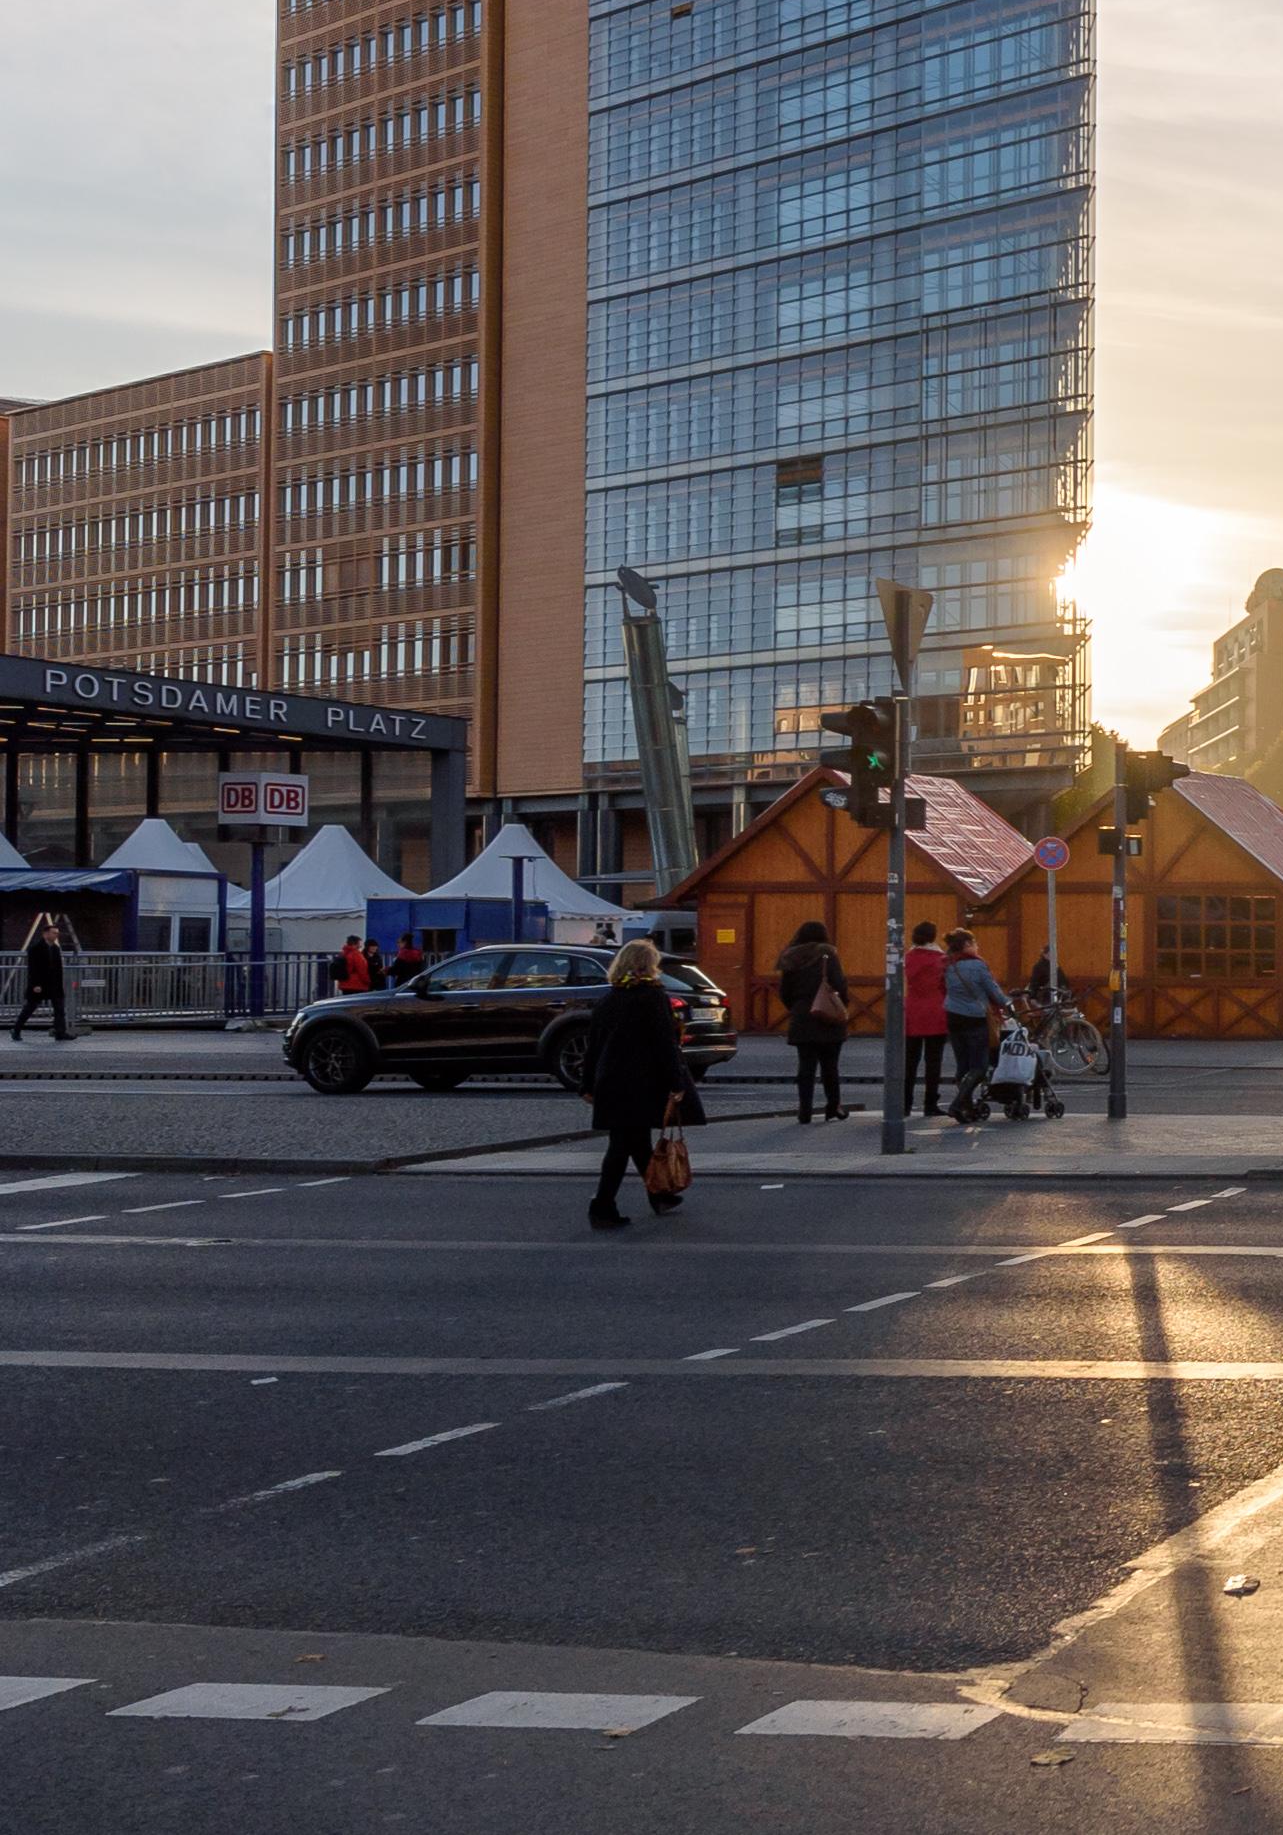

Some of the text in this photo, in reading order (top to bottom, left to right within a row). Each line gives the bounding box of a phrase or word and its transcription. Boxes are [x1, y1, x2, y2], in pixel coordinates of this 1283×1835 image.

[44, 668, 429, 741] POTSDAMER PLATZ
[225, 786, 256, 810] DB
[269, 787, 301, 811] DB
